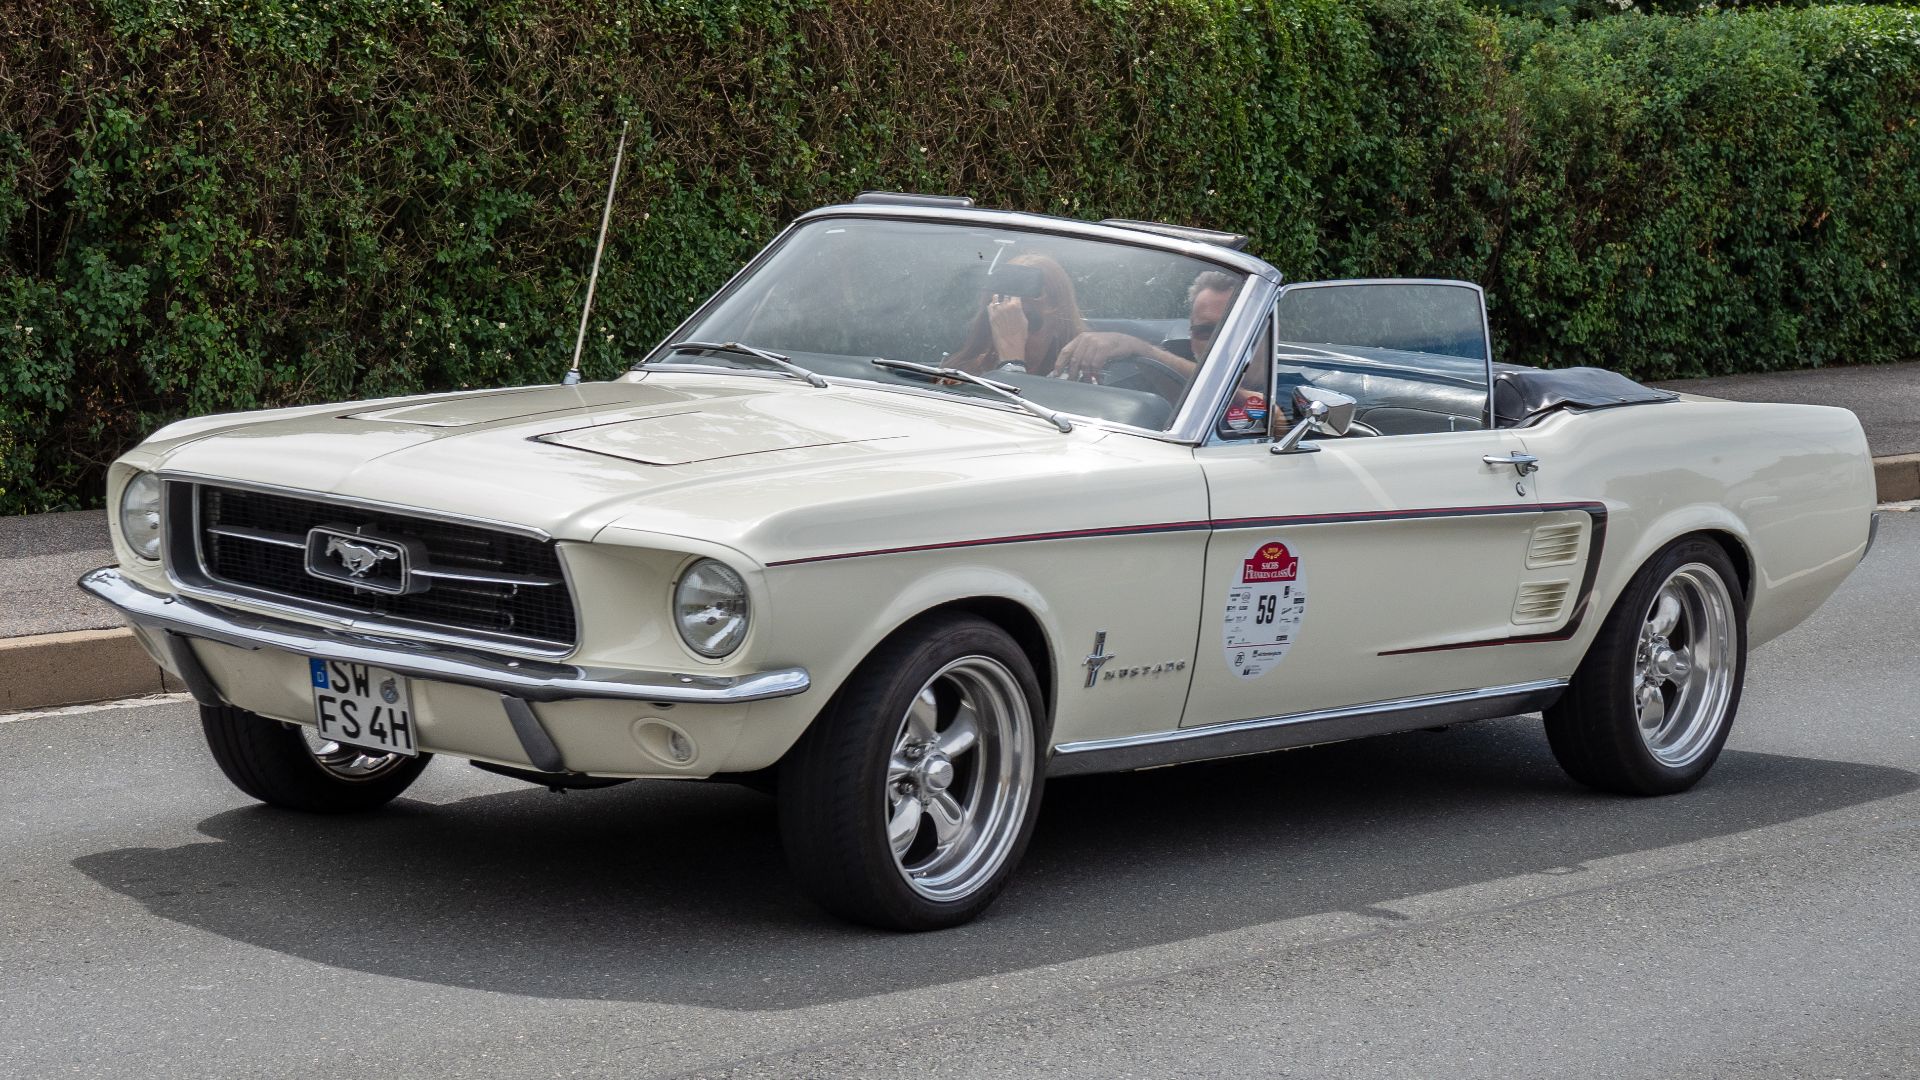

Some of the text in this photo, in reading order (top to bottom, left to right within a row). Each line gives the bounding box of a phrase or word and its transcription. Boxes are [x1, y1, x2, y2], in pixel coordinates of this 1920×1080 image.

[1256, 595, 1277, 625] 59
[316, 671, 325, 683] D
[329, 661, 370, 698] SW
[1104, 660, 1186, 680] MUSTANG
[318, 695, 412, 749] FS 4H
